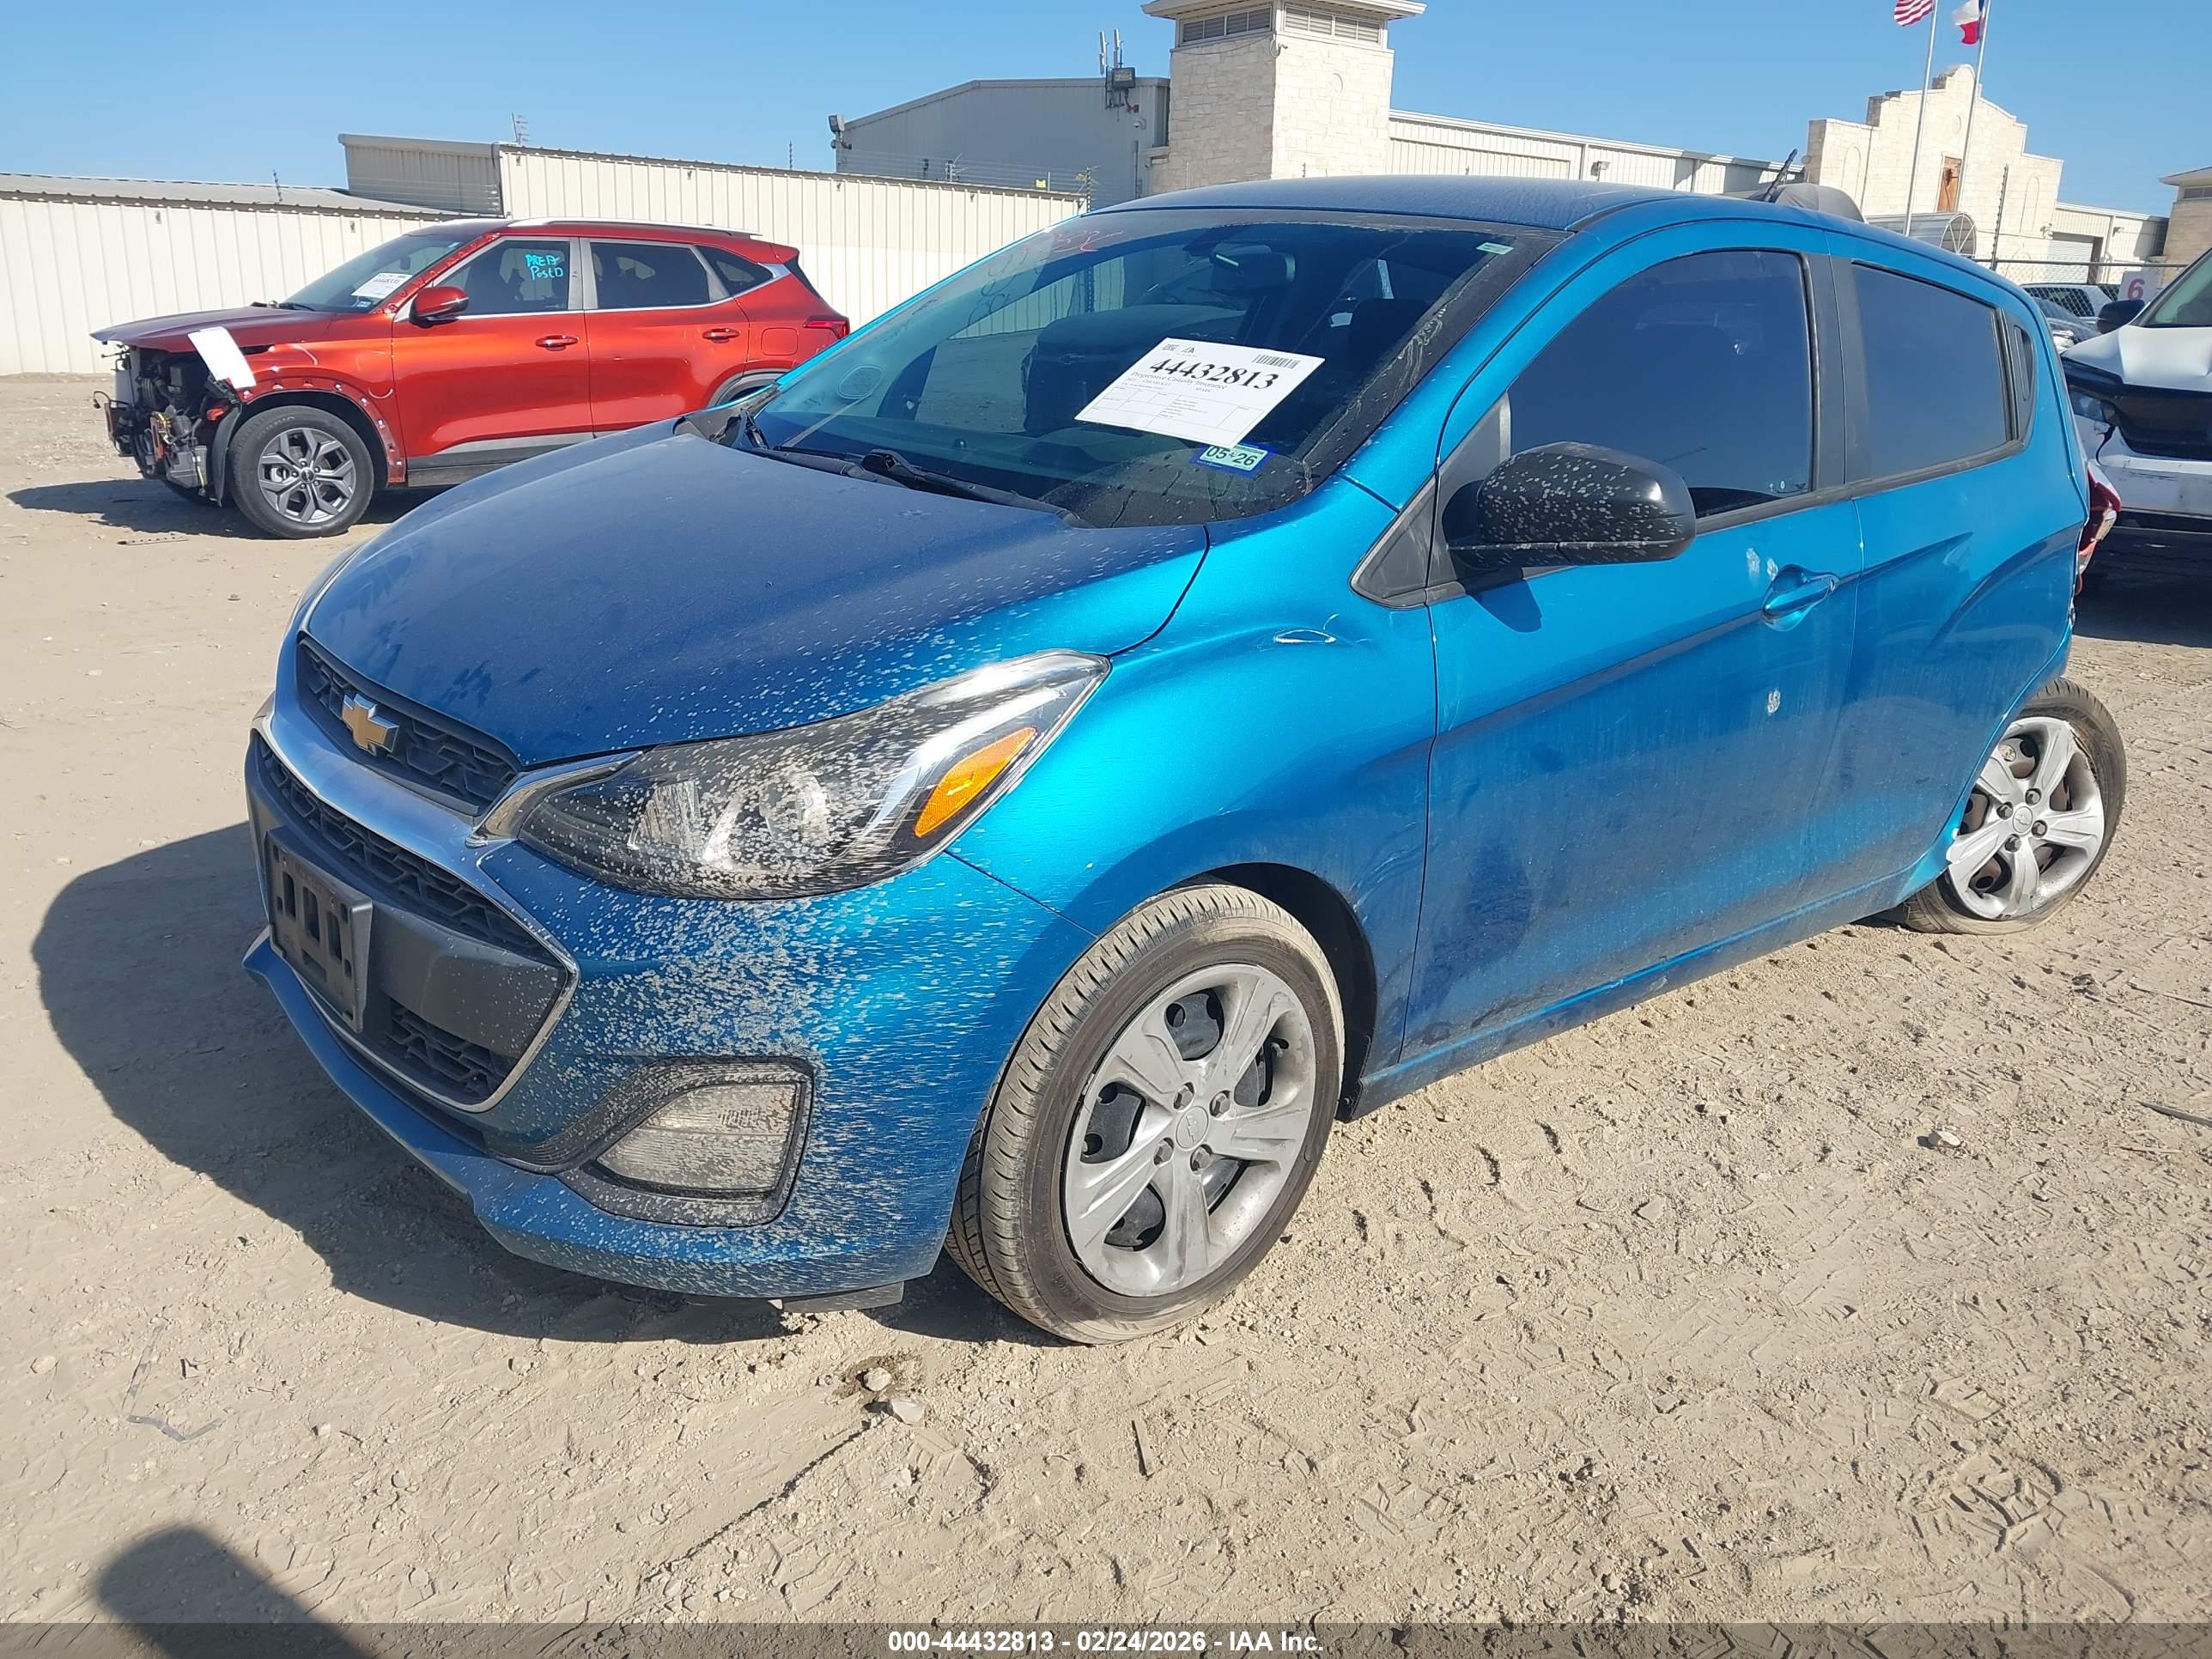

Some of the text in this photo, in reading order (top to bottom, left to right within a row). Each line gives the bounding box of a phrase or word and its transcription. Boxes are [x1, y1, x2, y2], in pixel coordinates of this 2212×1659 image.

[2128, 278, 2145, 299] 6
[1150, 358, 1279, 390] 44432813
[1206, 445, 1231, 459] 05
[1232, 453, 1258, 466] 26
